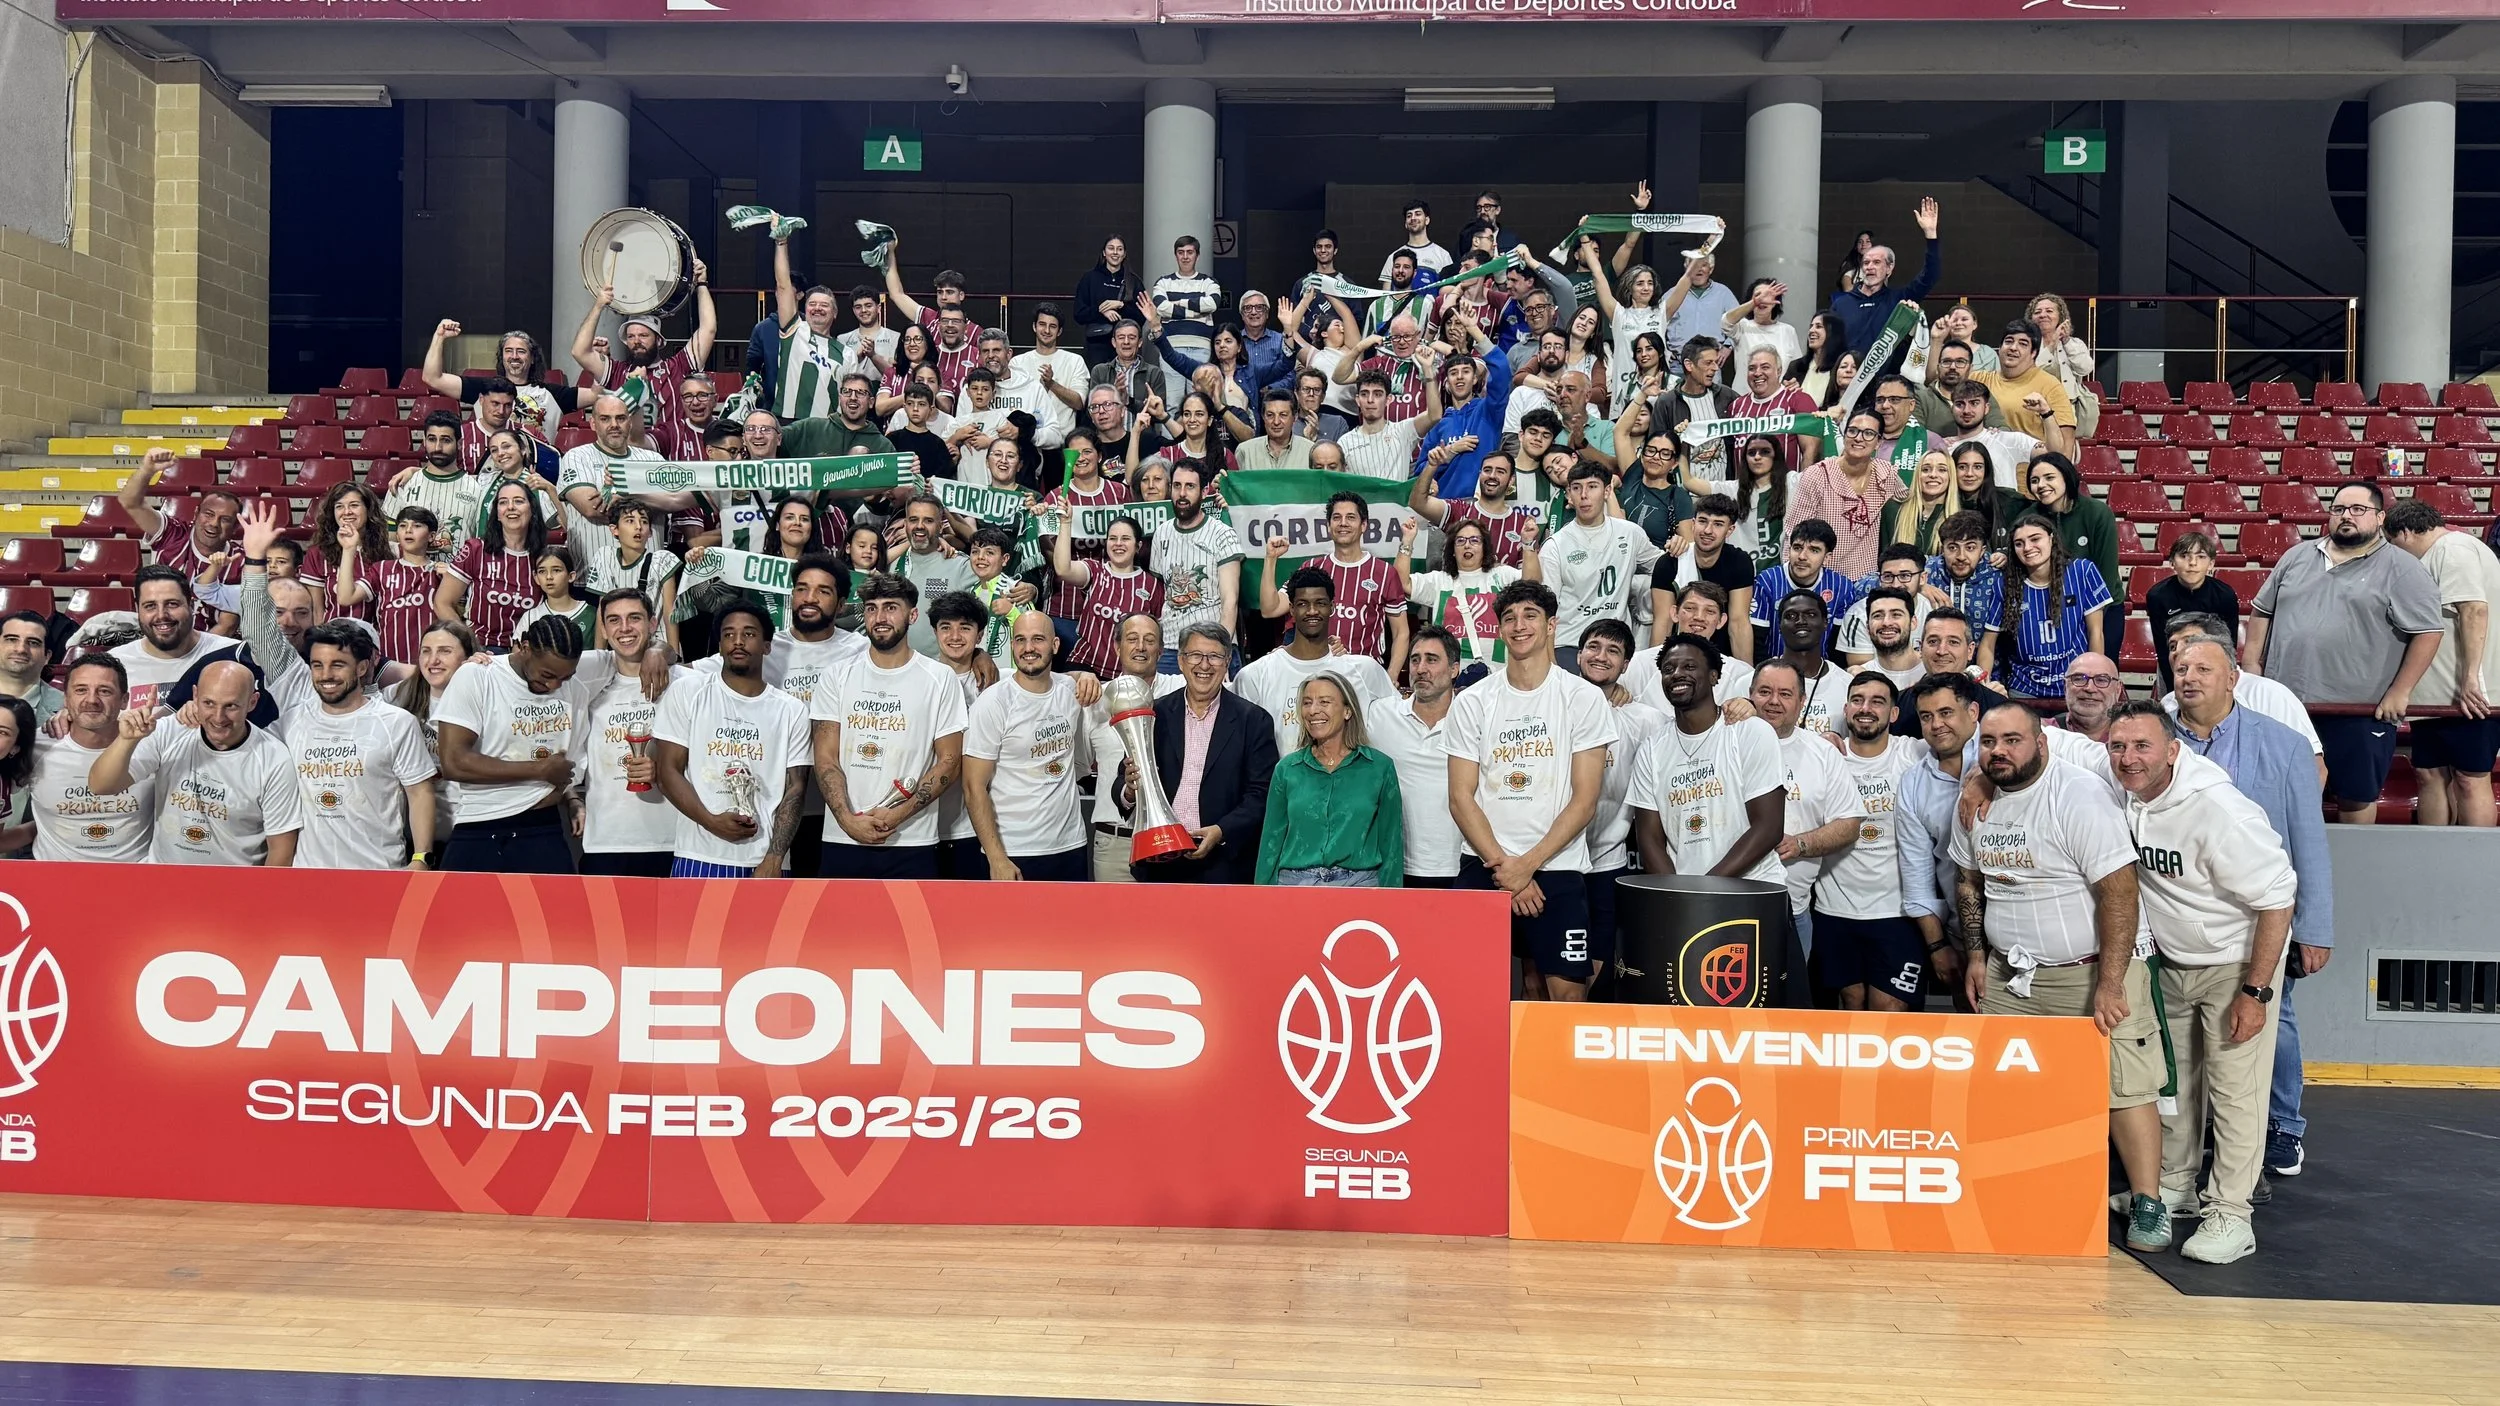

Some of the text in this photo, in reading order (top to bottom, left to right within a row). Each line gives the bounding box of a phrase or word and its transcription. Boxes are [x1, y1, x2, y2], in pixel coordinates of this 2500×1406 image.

[880, 134, 906, 164] A
[2063, 136, 2088, 166] B
[1248, 514, 1403, 547] CÓRDBA
[1597, 565, 1617, 598] 10
[487, 590, 535, 610] coto
[1093, 602, 1123, 623] cot
[1445, 619, 1499, 637] CajSur
[1730, 945, 1745, 954] FEB
[135, 951, 1206, 1069] CAMPEONES
[1574, 1025, 2040, 1072] BIENVENIDOS A
[246, 1079, 1082, 1147] SEGUNDA FEB 2025/26
[1803, 1127, 1960, 1152] PRIMERA
[1305, 1148, 1410, 1164] SEGUNDA
[1305, 1166, 1411, 1201] FEB
[1803, 1153, 1962, 1204] FEB
